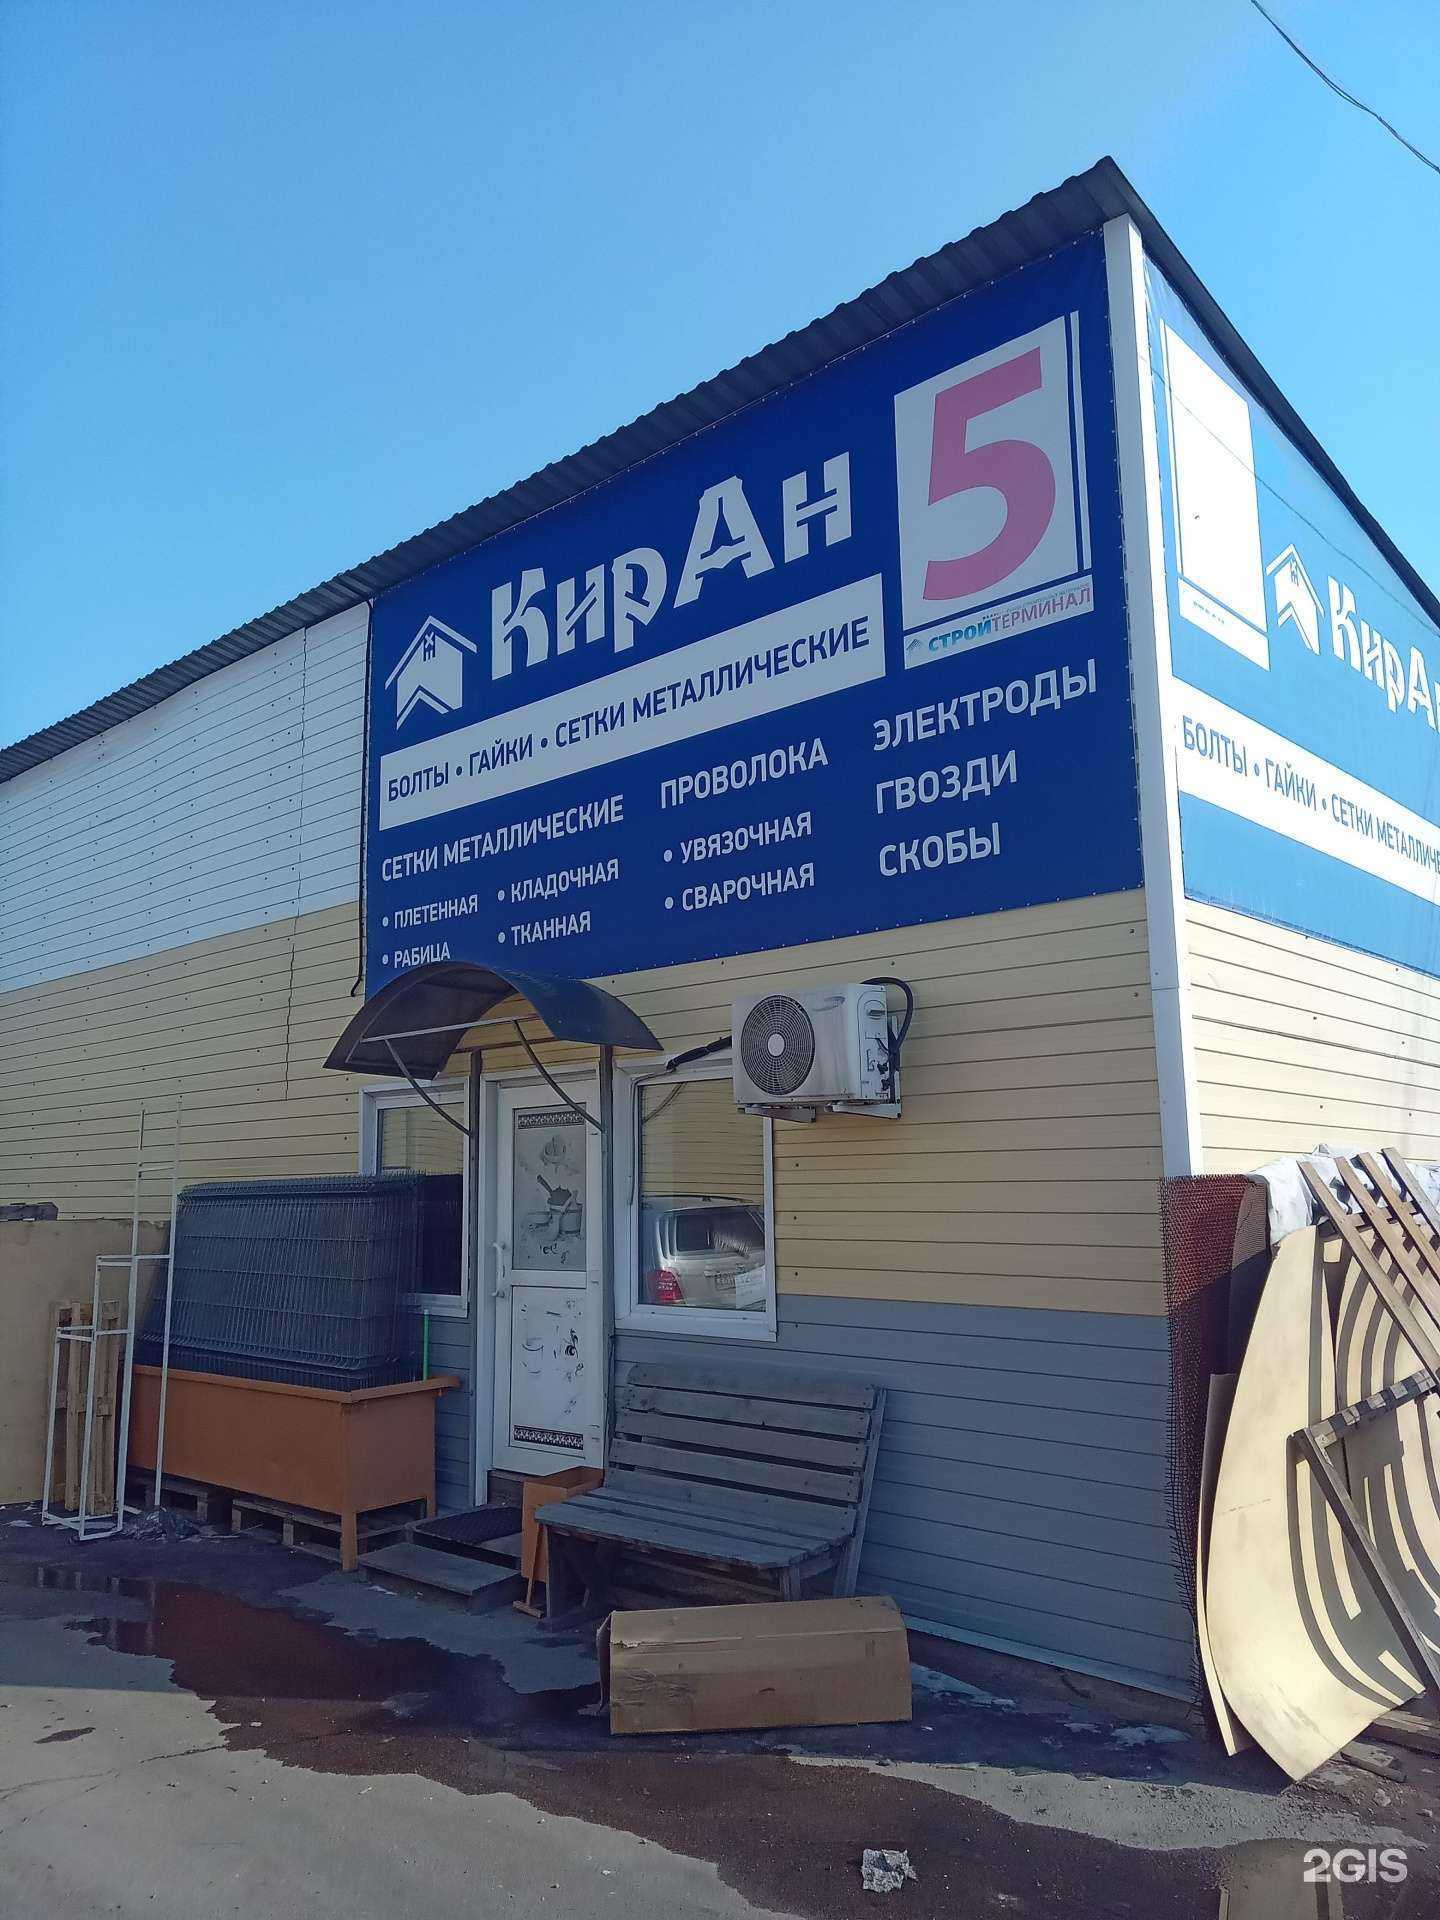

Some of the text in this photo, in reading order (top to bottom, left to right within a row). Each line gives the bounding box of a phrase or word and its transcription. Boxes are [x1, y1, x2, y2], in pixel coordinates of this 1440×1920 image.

[923, 346, 1056, 600] 5
[928, 588, 1091, 652] СТРОЙТЕРМИНАЛ
[388, 616, 869, 801] БОЛТЫ ГАЙКИ СЕТКИ МЕТАЛЛИЧЕСКИЕ
[874, 659, 1097, 751] ЭЛЕКТРОДЫ
[661, 738, 828, 808] ПРОВОЛОКА
[876, 750, 1017, 813] ГВОЗДИ
[1183, 715, 1247, 776] БОЛТЫ
[1265, 758, 1316, 811] ГАЙКИ
[1331, 793, 1373, 839] СЕТКИ
[382, 795, 624, 881] СЕТКИ МЕТАЛЛИЧЕСКИЕ
[680, 812, 812, 863] УВЯЗОЧНАЯ
[880, 823, 1001, 876] СКОБЫ
[394, 894, 478, 929] ПЛЕТЕННАЯ
[511, 858, 619, 902] КЛАДОЧНАЯ
[682, 863, 815, 910] СВАРОЧНАЯ
[394, 942, 450, 968] РАБИЦА
[511, 911, 591, 945] ТКАННАЯ
